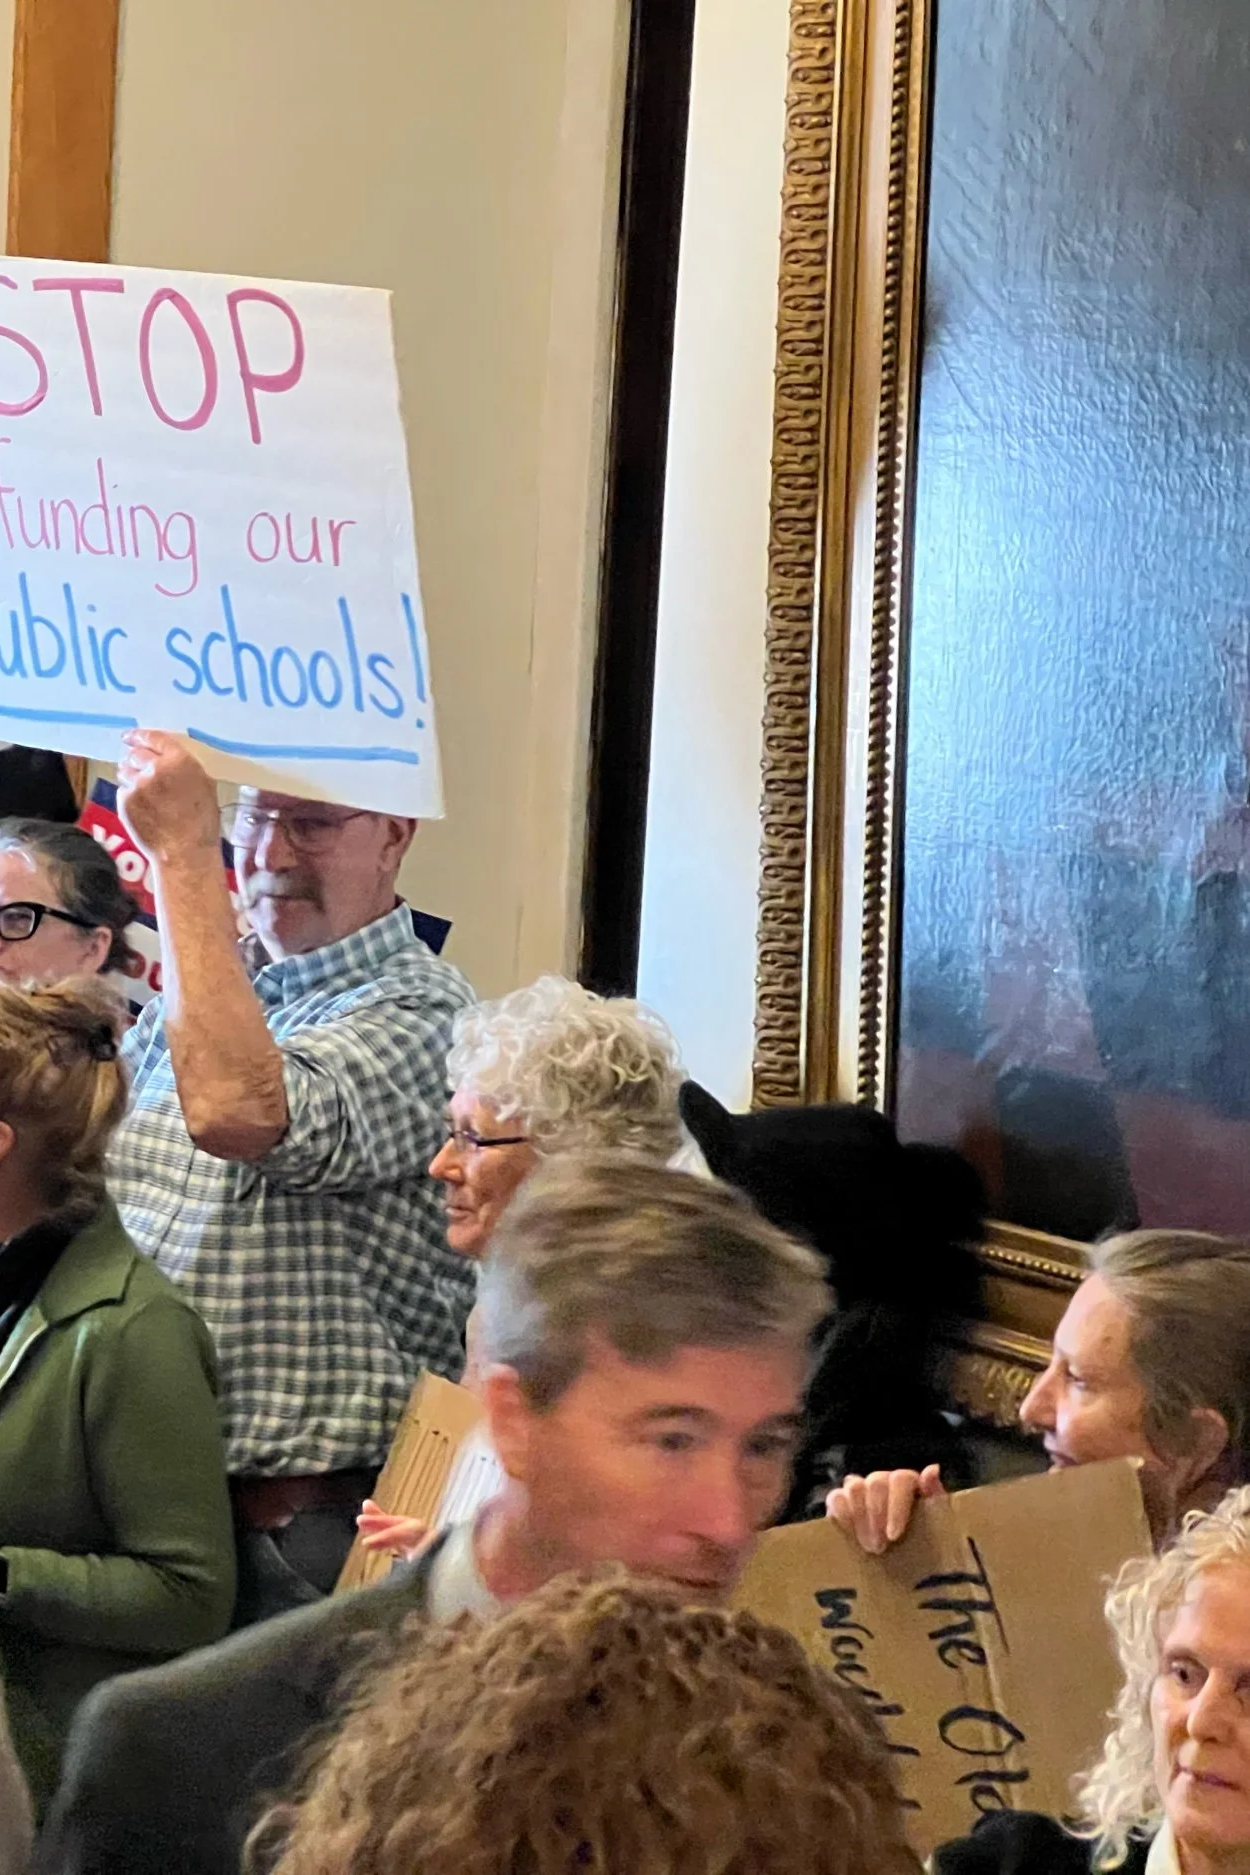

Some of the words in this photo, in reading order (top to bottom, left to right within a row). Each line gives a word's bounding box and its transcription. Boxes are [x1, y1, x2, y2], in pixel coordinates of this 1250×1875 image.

[246, 509, 357, 568] our
[170, 583, 427, 730] schools!
[915, 1537, 1010, 1669] The
